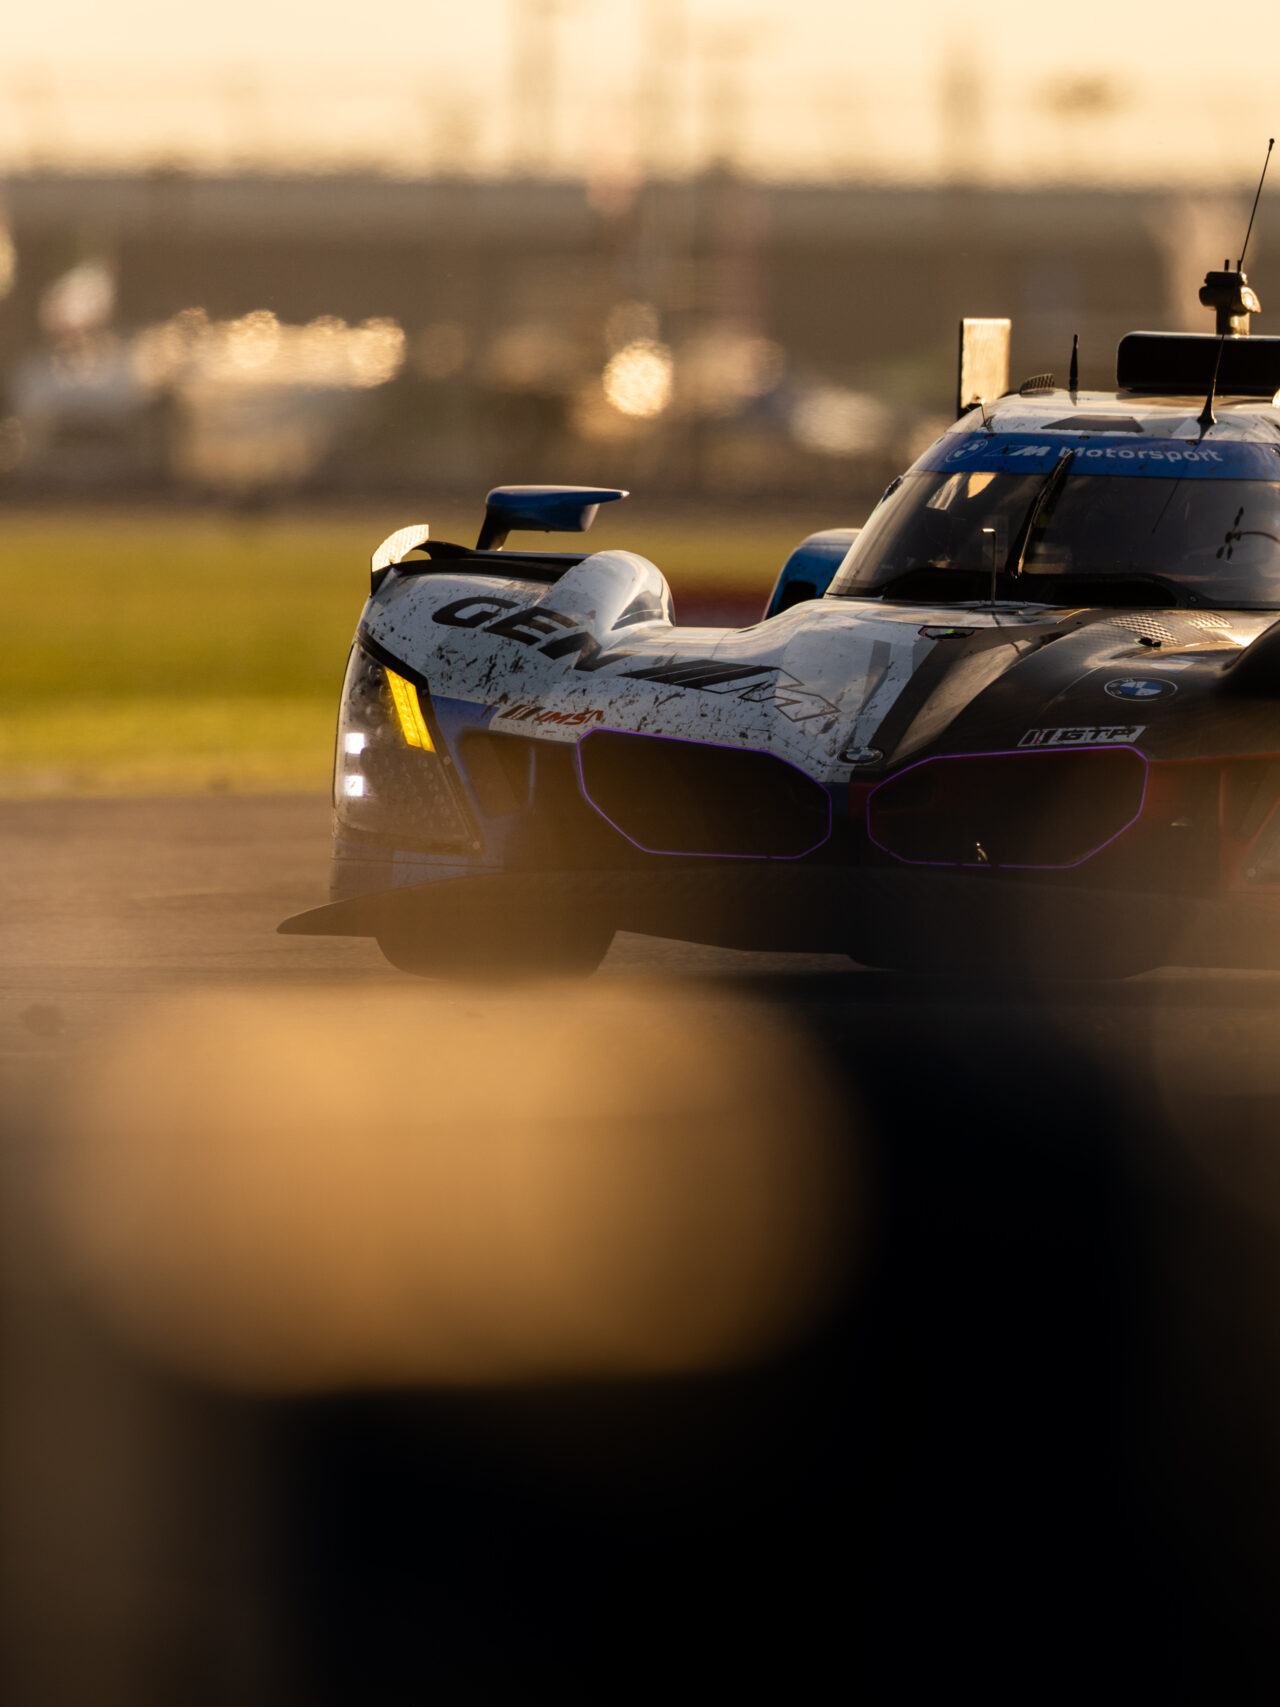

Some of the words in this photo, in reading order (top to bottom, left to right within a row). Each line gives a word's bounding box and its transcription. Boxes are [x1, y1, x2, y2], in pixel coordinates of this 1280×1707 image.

[1058, 446, 1223, 462] Motorsport
[432, 596, 638, 672] GEN
[534, 710, 605, 726] IMSA
[1057, 727, 1139, 741] GTP
